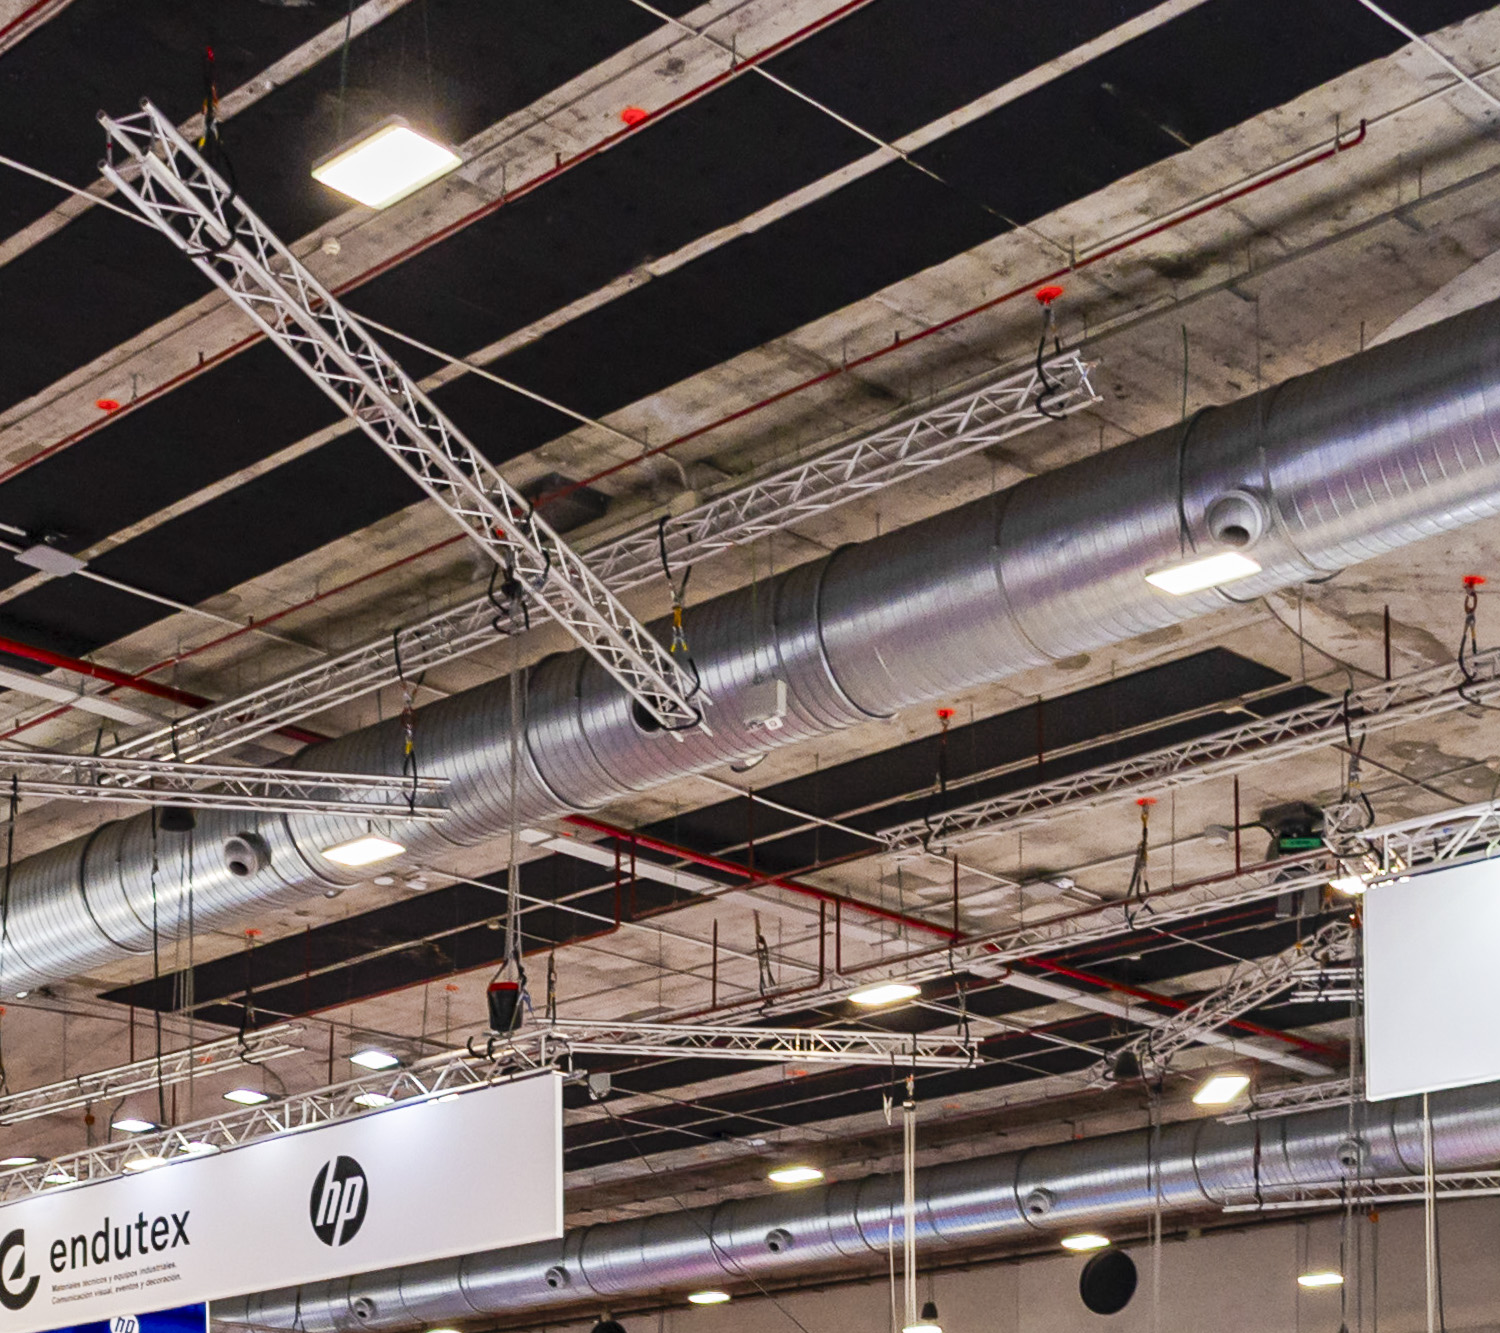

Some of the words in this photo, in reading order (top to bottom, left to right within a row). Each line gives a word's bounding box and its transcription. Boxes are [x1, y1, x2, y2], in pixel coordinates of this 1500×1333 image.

[313, 1156, 366, 1247] hp
[49, 1210, 190, 1273] endutex
[51, 1281, 81, 1292] Materiales
[82, 1276, 107, 1287] técnicos
[113, 1270, 138, 1282] equipos
[51, 1291, 93, 1304] Comunicación
[114, 1282, 139, 1293] eventos
